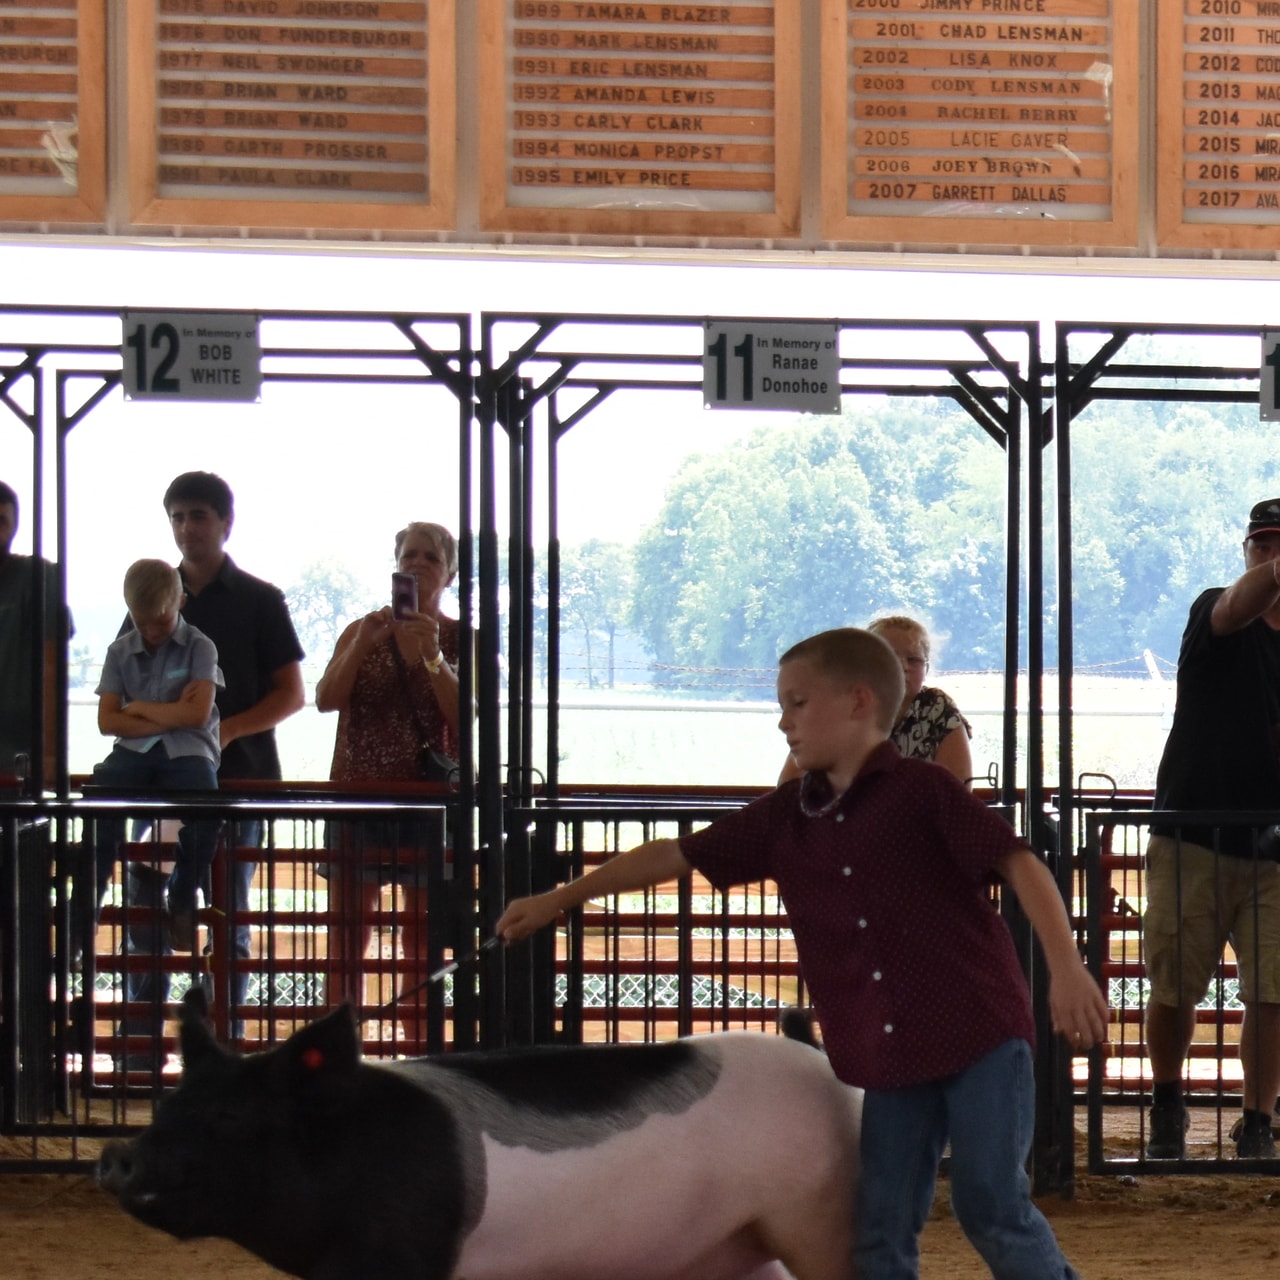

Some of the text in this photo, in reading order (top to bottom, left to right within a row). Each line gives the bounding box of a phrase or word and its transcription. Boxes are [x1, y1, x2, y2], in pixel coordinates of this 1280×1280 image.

[296, 2, 378, 16] JOHNSON
[576, 6, 647, 20] TAMARA
[661, 8, 731, 23] BLAZER
[1200, 0, 1241, 15] 2010
[224, 27, 411, 45] DON FUNDERBURGH
[876, 23, 1083, 42] 2001 CHAD LENSMAN
[1200, 27, 1235, 43] 2011
[574, 33, 621, 48] MARK
[633, 35, 718, 51] LENSMAN
[222, 55, 364, 73] NEIL SWONGER
[863, 51, 1057, 68] 2002 LISA KNOX
[1200, 56, 1240, 71] 2012
[517, 60, 708, 78] 1991 ERIC LENSMAN
[224, 82, 347, 100] BRIAN WARD
[931, 79, 976, 93] CODY
[991, 80, 1081, 94] LENSMAN
[1200, 83, 1241, 98] 2013
[574, 87, 647, 102] AMANDA
[661, 90, 715, 104] LEWIS
[299, 114, 347, 128] WARD
[517, 114, 703, 131] 1993 CARLY CLARK
[937, 106, 1011, 120] RACHEL
[1019, 108, 1078, 122] BERRY
[1199, 110, 1240, 126] 2014
[864, 131, 1068, 149] 2005 LACIE GAVER
[1199, 137, 1240, 152] 2015
[305, 143, 387, 159] PROSSER
[517, 141, 724, 160] 1994 MONICA PROPST
[866, 160, 1052, 176] 2006 JOEY BROWN
[1199, 164, 1240, 180] 2016
[296, 171, 352, 187] CLARK
[517, 170, 691, 187] 1995 EMILY PRICE
[869, 183, 1067, 203] 2007 GARRETT DALLAS
[1199, 192, 1240, 207] 2017
[1256, 193, 1279, 209] AVA
[183, 328, 256, 339] In Memory of
[199, 345, 232, 361] BOB
[757, 338, 836, 352] In Memory of
[127, 323, 180, 392] 12
[772, 354, 818, 370] Ranae
[708, 333, 753, 401] 11
[191, 368, 241, 385] WHITE
[762, 377, 828, 394] Donohoe
